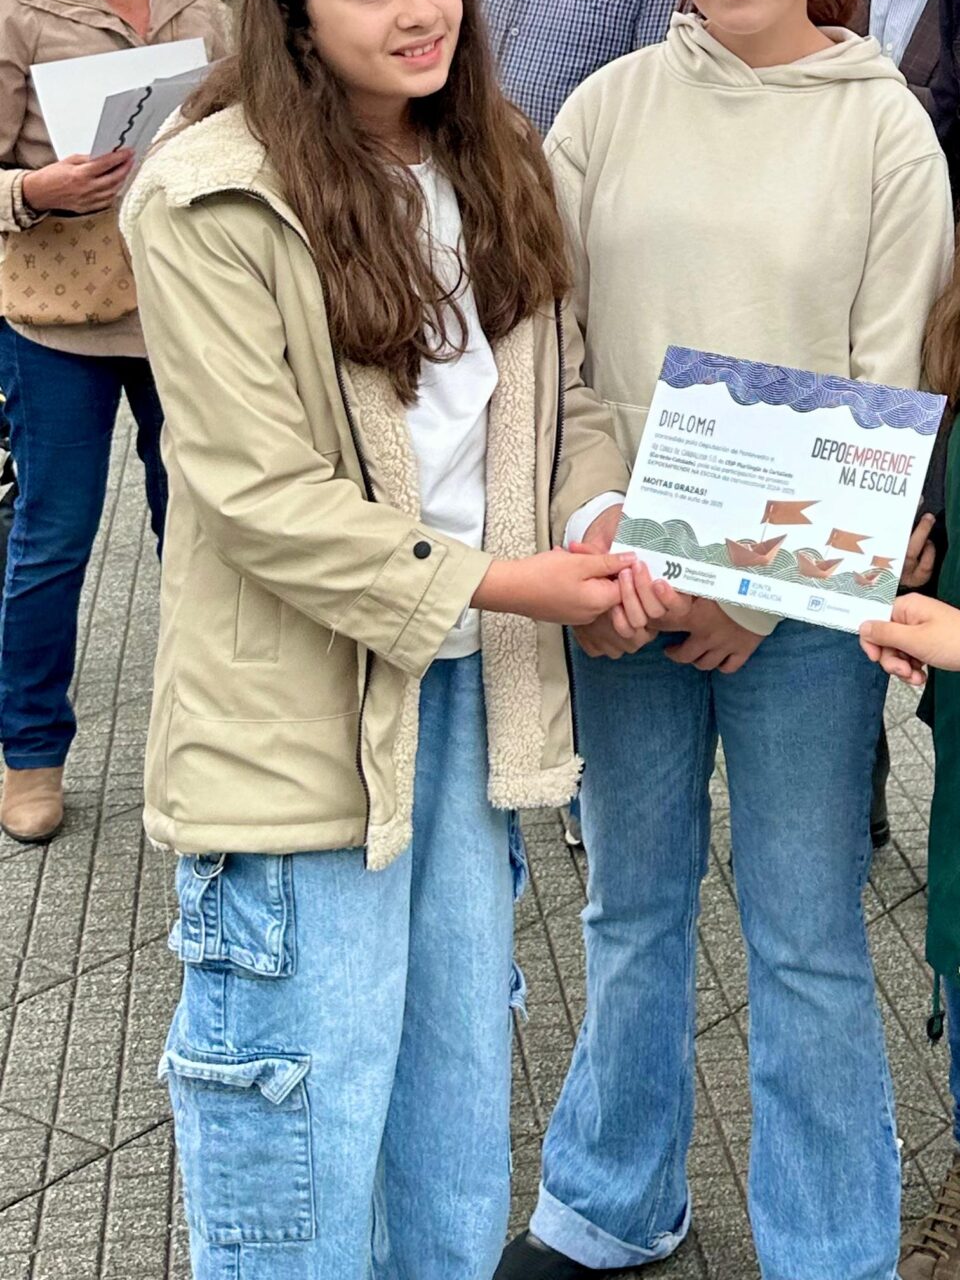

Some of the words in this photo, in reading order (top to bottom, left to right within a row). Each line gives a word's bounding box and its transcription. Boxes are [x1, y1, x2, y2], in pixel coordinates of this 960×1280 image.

[659, 409, 716, 436] DIPLOMA
[811, 437, 916, 476] DEPOEMPRENDE
[643, 476, 673, 489] MOITAS
[674, 483, 708, 496] GRAZAS!
[839, 466, 856, 487] NA
[860, 470, 907, 497] ESCOLA
